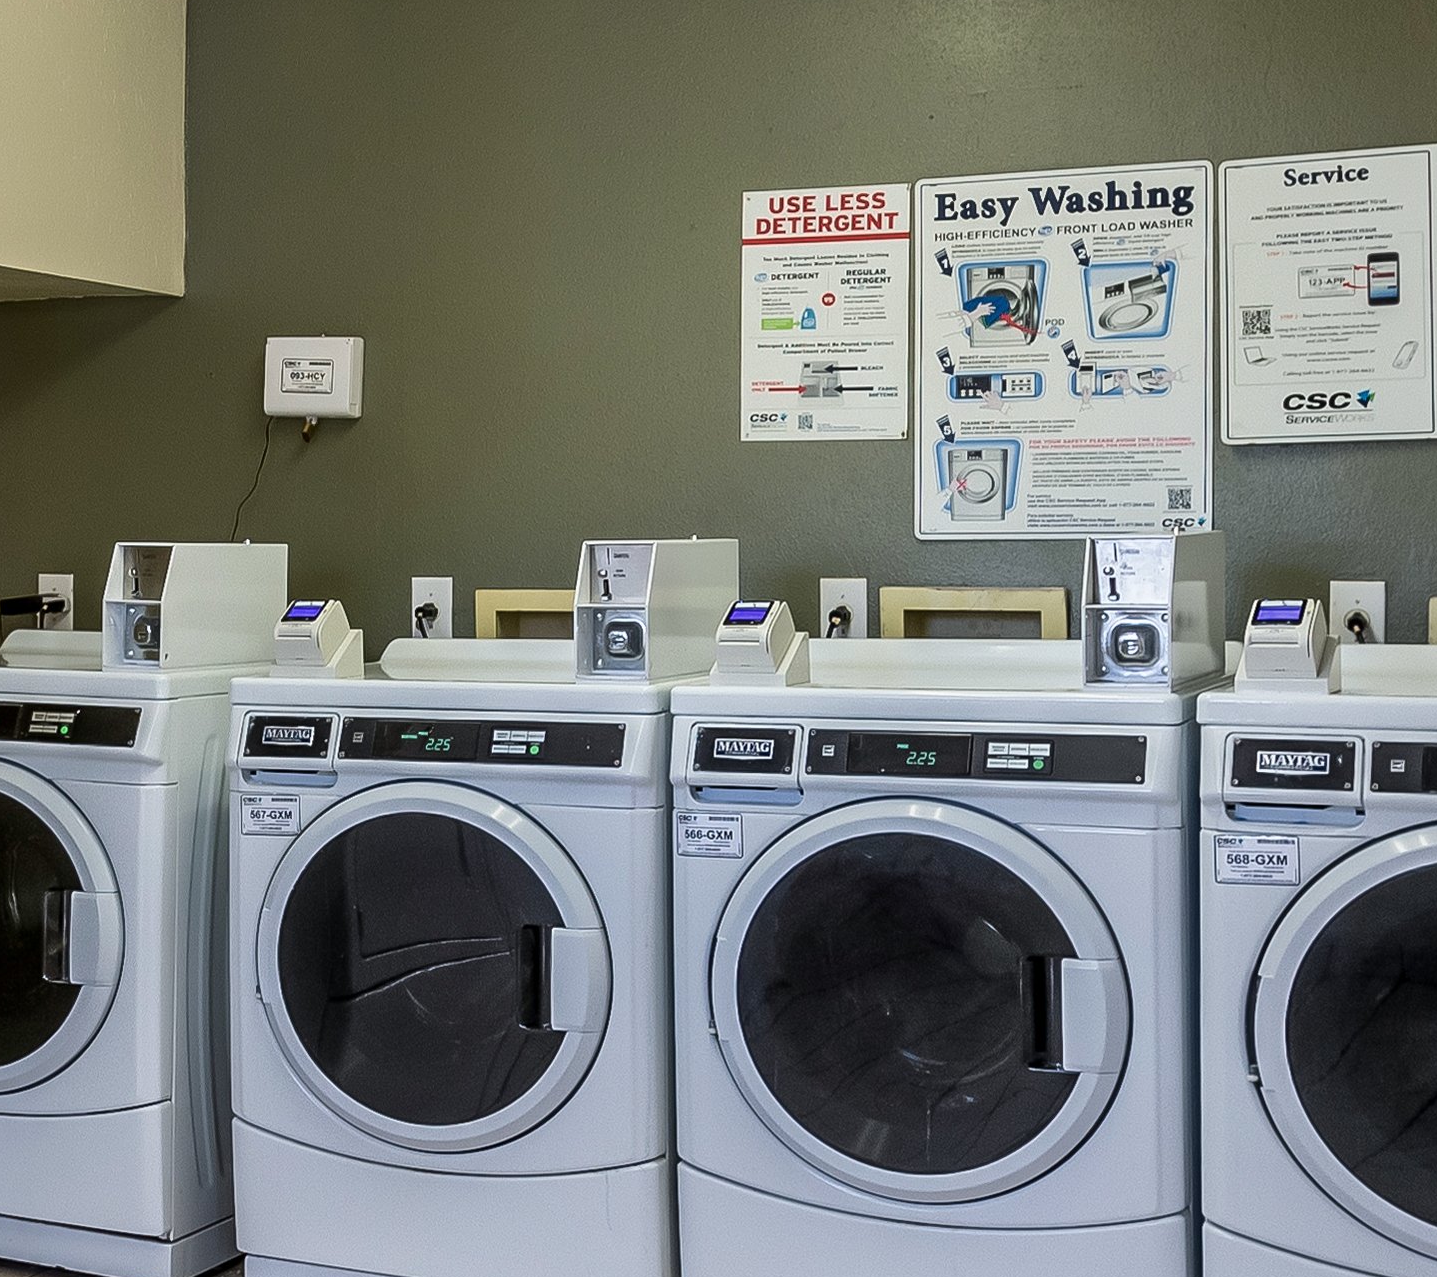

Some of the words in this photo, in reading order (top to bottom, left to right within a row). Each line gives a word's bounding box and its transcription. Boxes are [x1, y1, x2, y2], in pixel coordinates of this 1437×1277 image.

[1284, 165, 1369, 187] Service
[769, 195, 816, 214] USE
[825, 192, 886, 211] LESS
[934, 193, 1019, 227] Easy
[1028, 180, 1195, 216] Washing
[756, 212, 899, 235] DETERGENT
[934, 227, 1036, 242] HIGH-EFFICIENCY
[1056, 223, 1098, 235] FRONT
[1101, 221, 1136, 233] LOAD
[1140, 218, 1194, 230] WASHER
[1077, 249, 1087, 260] 2
[771, 272, 820, 281] DETERGENT
[846, 268, 887, 277] REGULAR
[840, 276, 892, 285] DETERGENT
[1045, 318, 1065, 326] POD
[1283, 392, 1352, 411] CSC
[749, 413, 779, 423] CSC
[942, 425, 951, 436] 5
[1161, 517, 1195, 528] CSC
[265, 728, 312, 740] MAYTAG
[425, 738, 451, 752] 2.25
[718, 741, 770, 752] MAYTAG
[906, 751, 936, 766] 2.25
[1261, 754, 1325, 767] MAYTAG
[249, 809, 293, 820] 567-GXM
[685, 829, 733, 841] 566-GXM
[1227, 853, 1288, 866] 568-GXM
